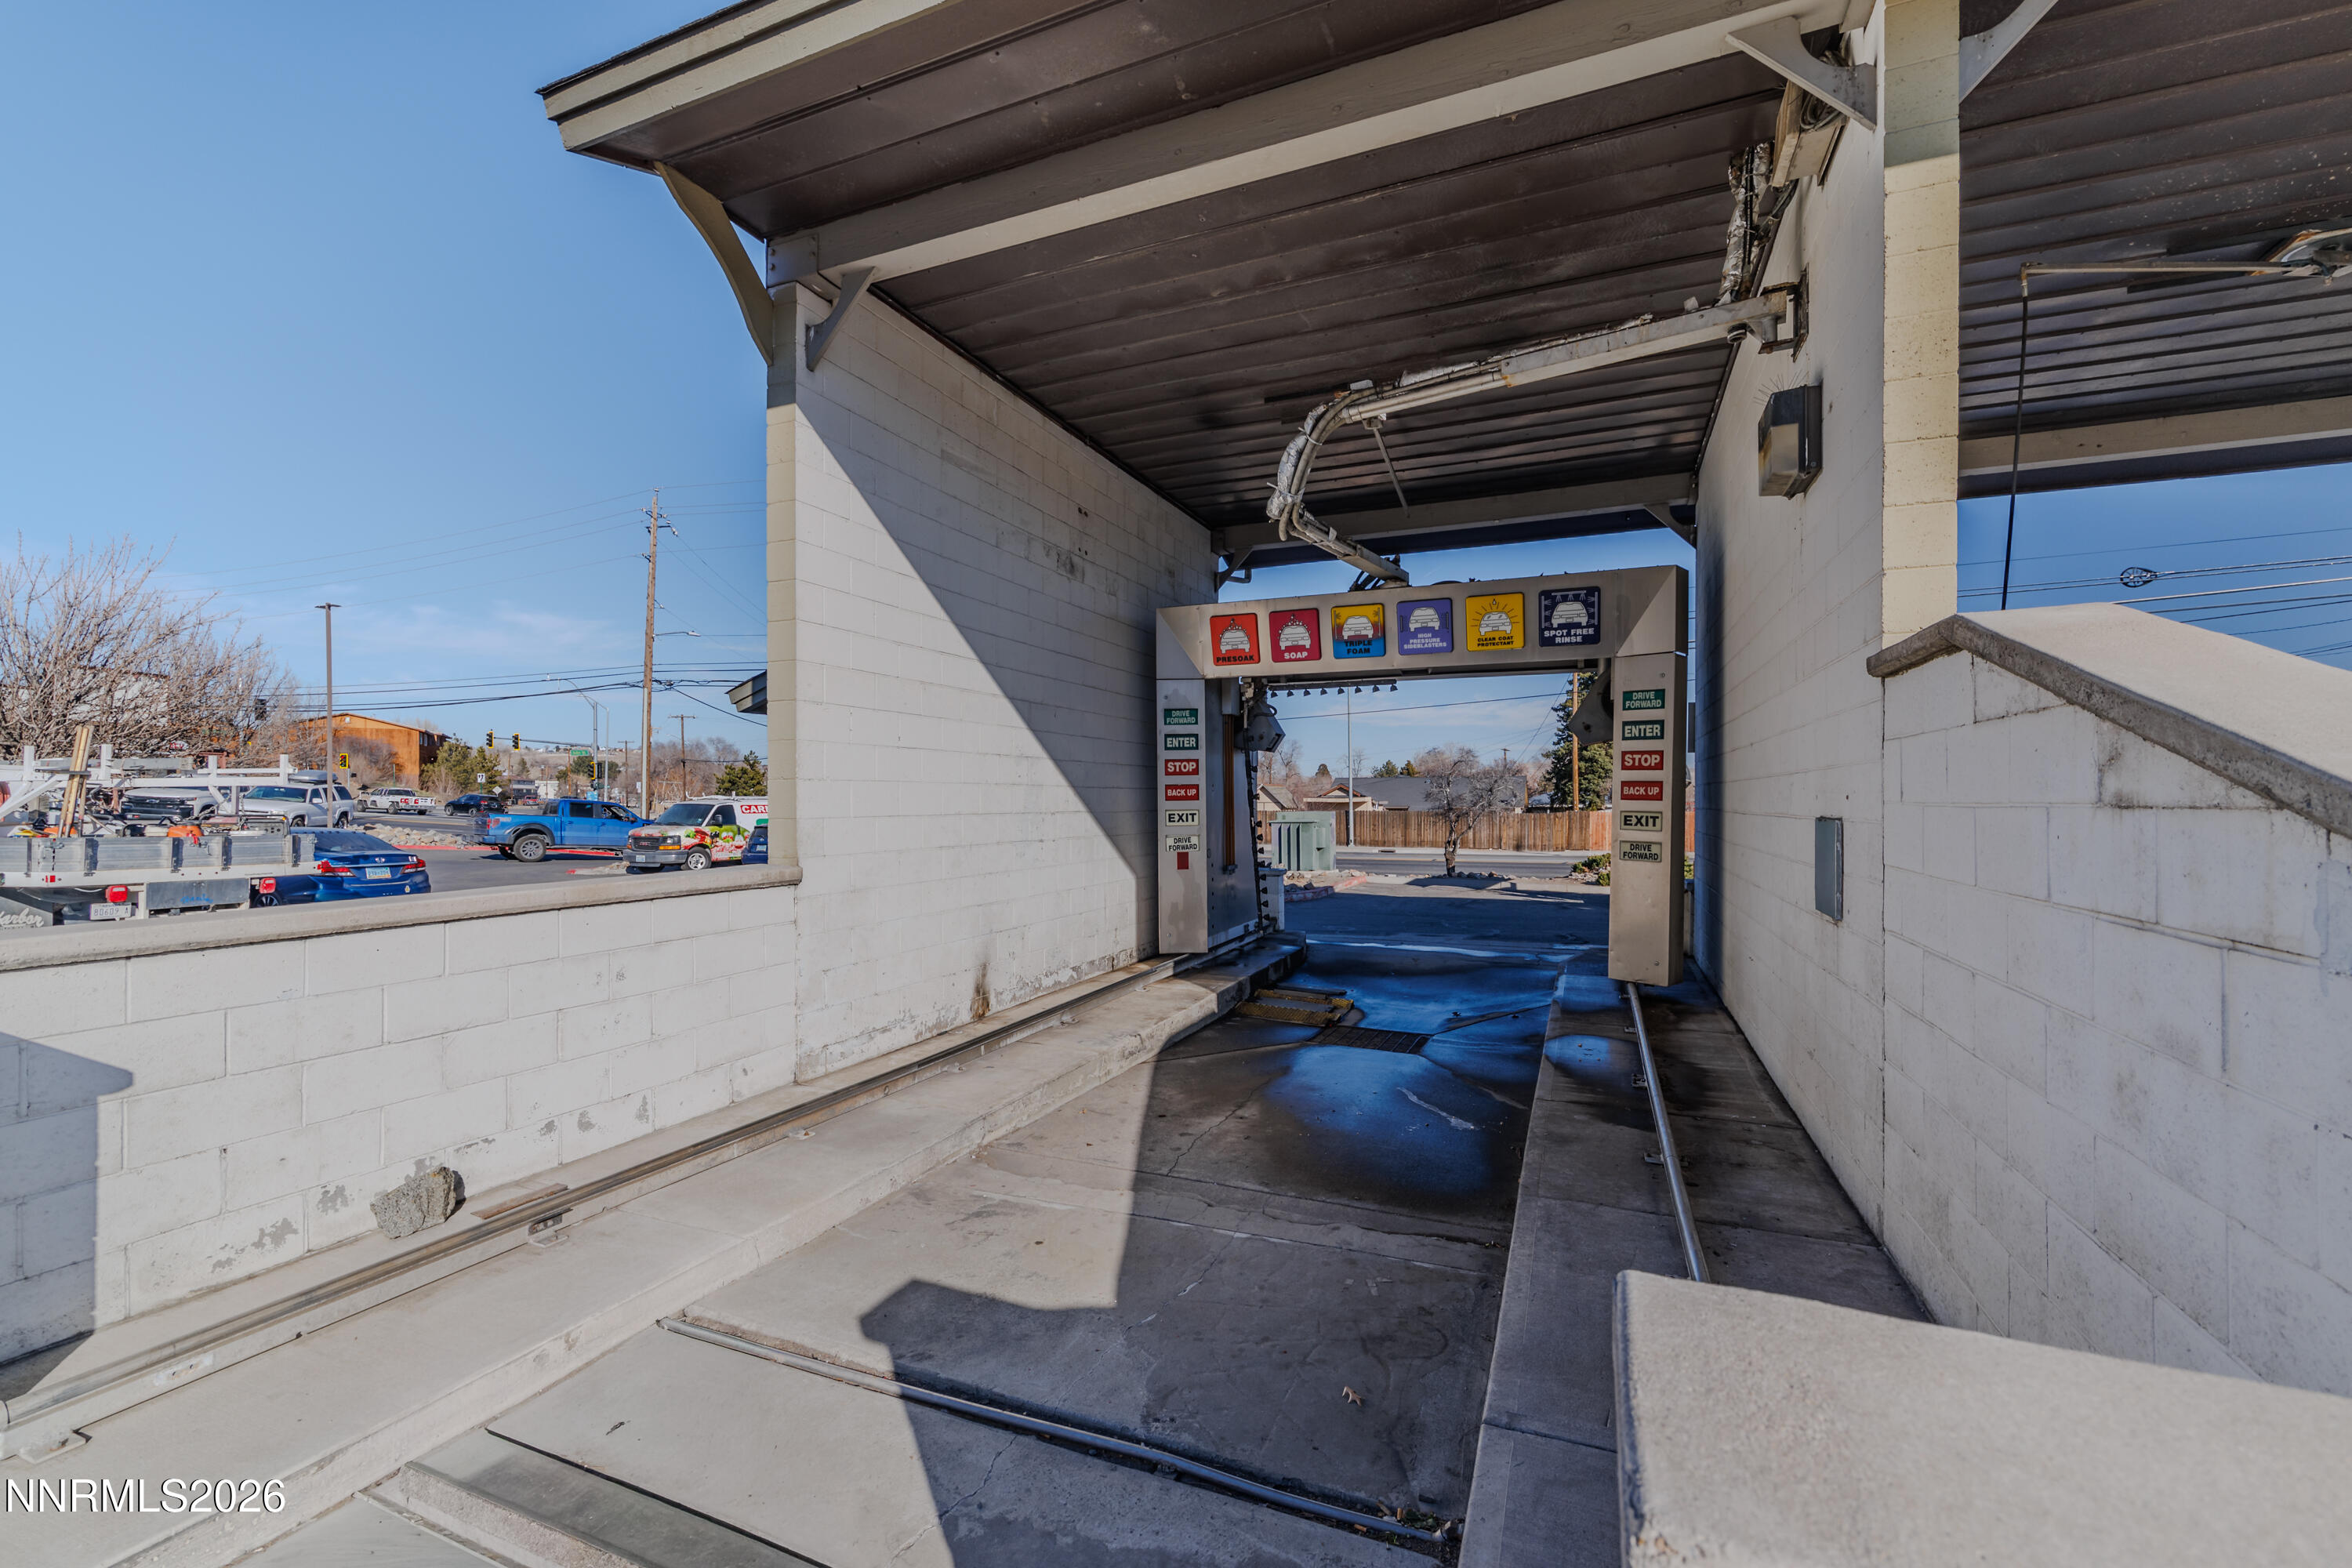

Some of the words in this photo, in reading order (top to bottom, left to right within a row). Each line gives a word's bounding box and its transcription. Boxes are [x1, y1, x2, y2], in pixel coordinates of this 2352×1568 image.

[1216, 655, 1255, 663] PRESOAK
[1632, 691, 1655, 700] DRIVE
[1625, 699, 1662, 709] FORWARD
[1624, 724, 1661, 737] ENTER
[1167, 737, 1196, 747] ENTER
[1624, 754, 1661, 767] STOP
[1167, 761, 1196, 772] STOP
[1623, 786, 1646, 795] BACK
[1647, 786, 1660, 795] UP
[1168, 813, 1196, 822] EXIT
[1623, 815, 1659, 827] EXIT
[1630, 843, 1652, 852] DRIVE
[1623, 851, 1659, 861] FORWARD
[93, 907, 119, 916] 80609
